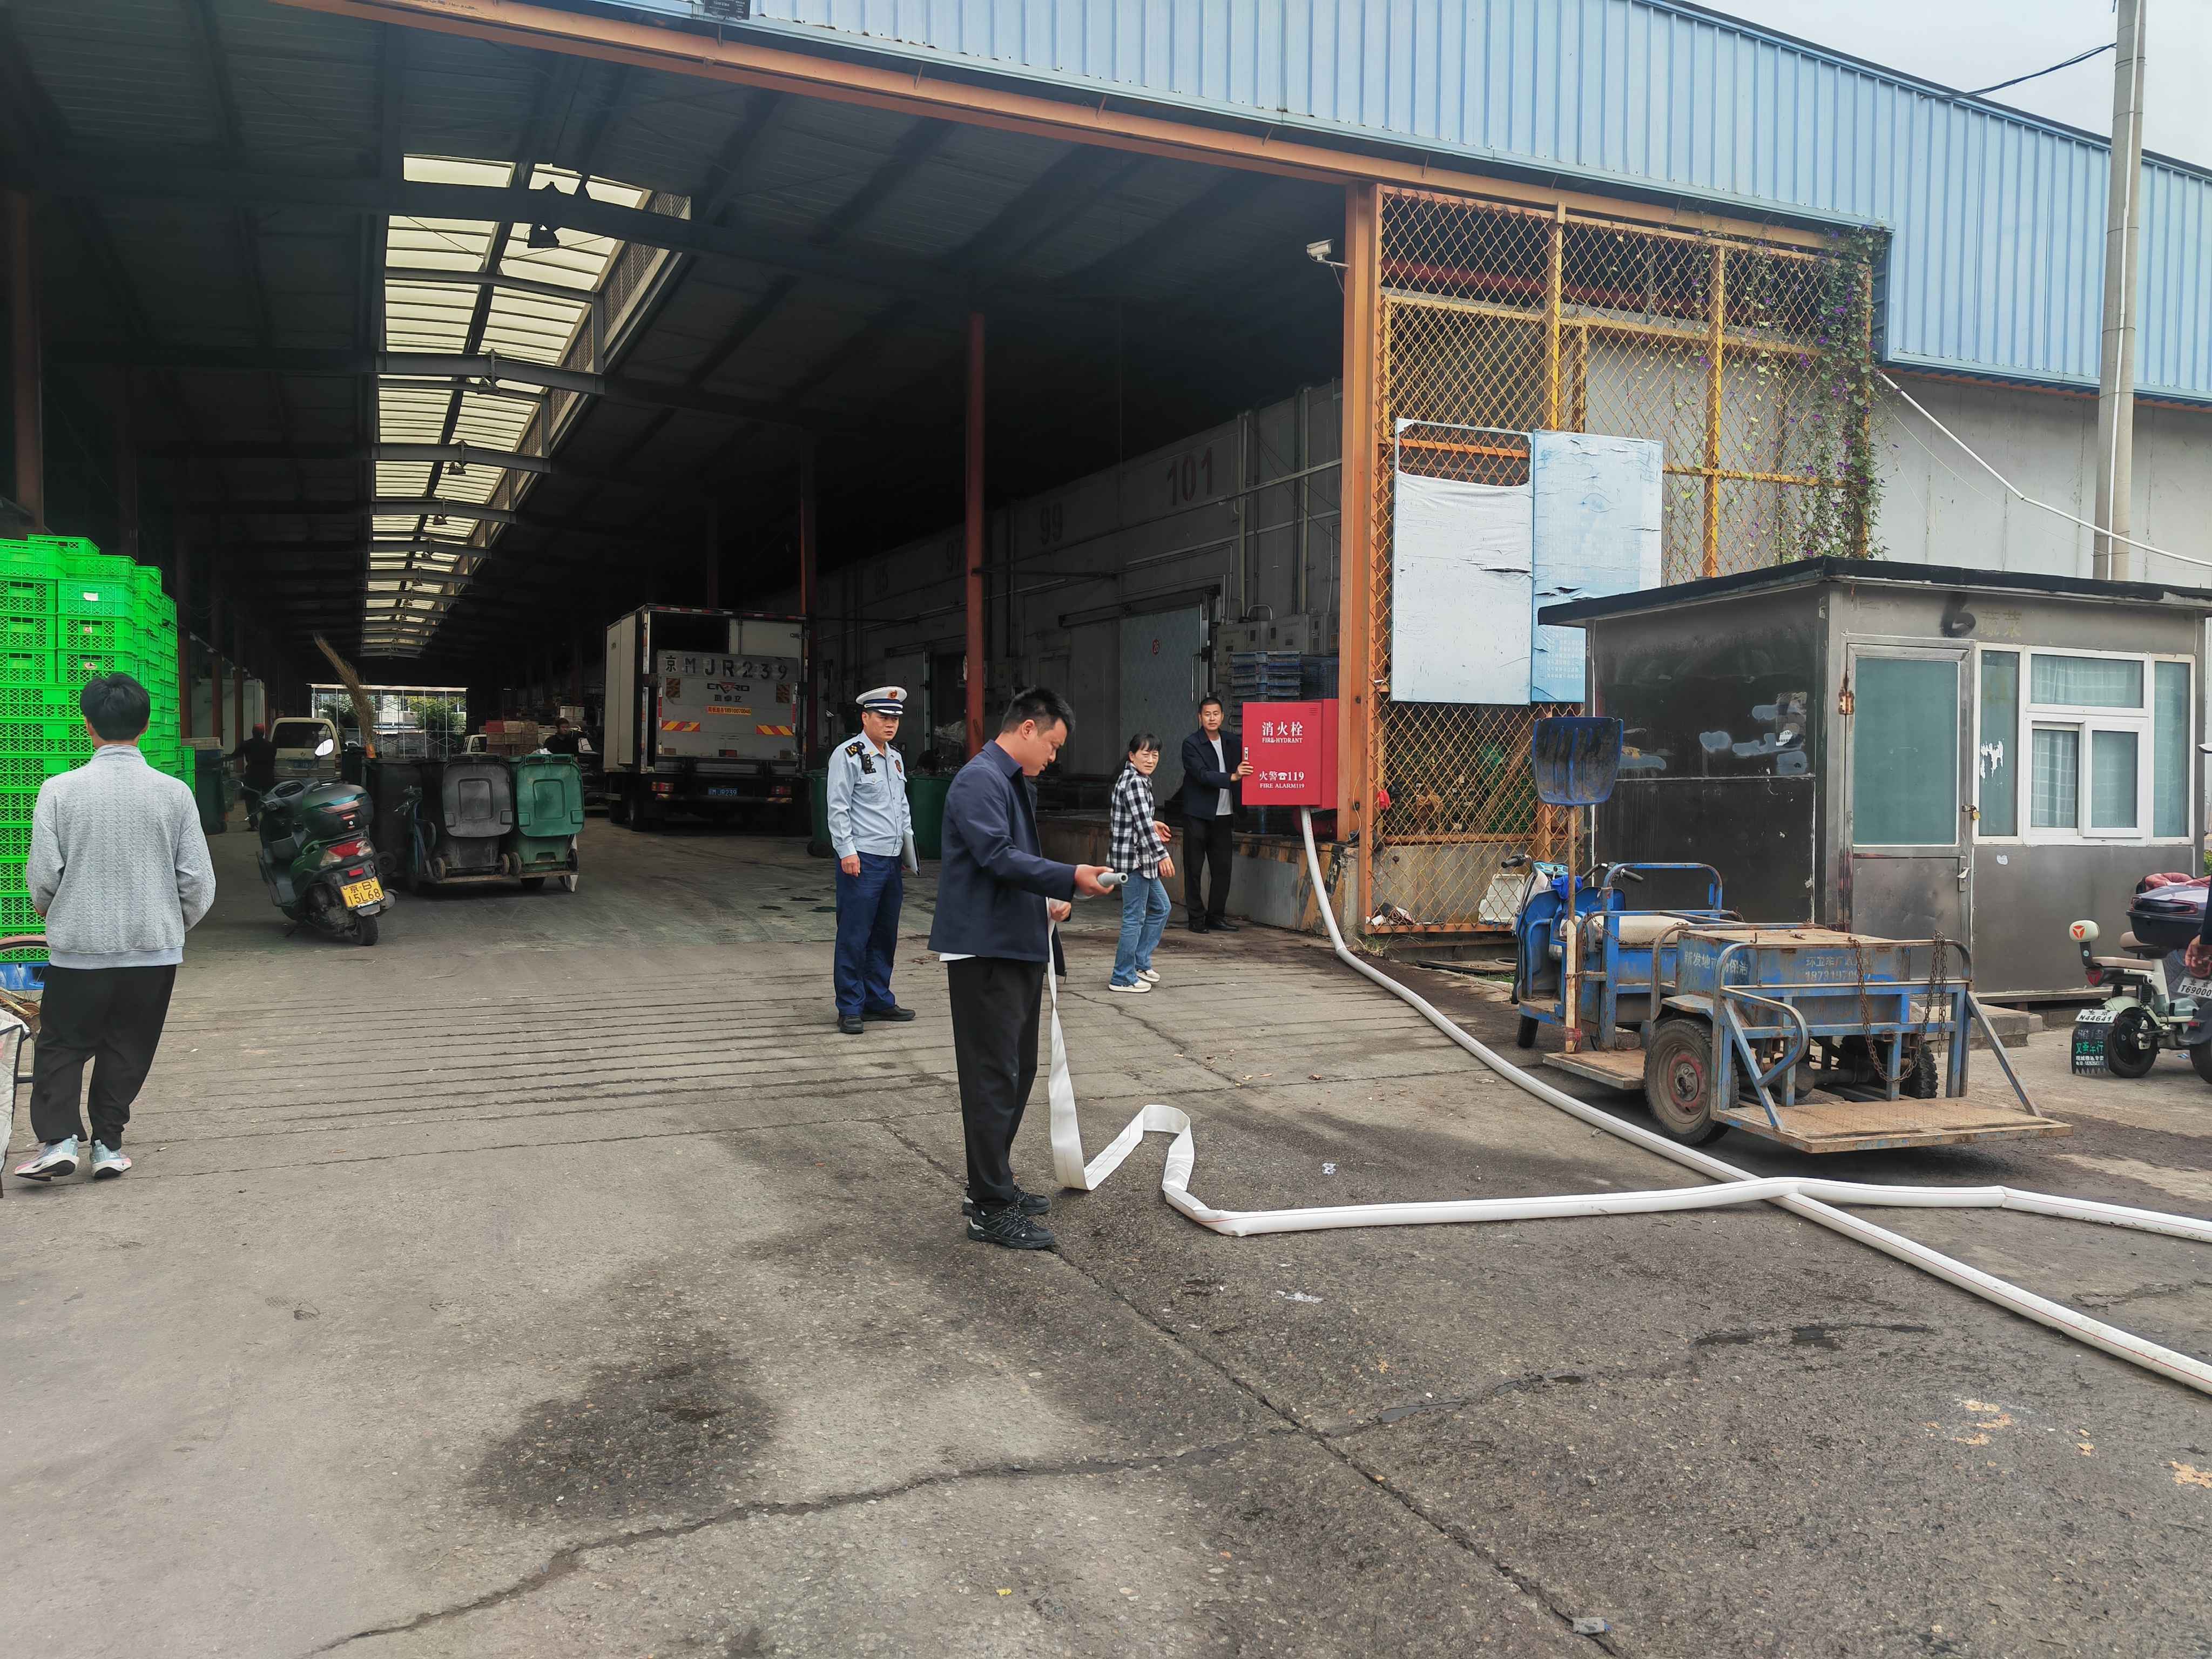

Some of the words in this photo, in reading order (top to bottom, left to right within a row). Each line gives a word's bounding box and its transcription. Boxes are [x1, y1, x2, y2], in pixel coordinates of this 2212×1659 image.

[1166, 447, 1215, 506] 101
[1039, 502, 1064, 545] 99
[947, 536, 963, 572] 97
[665, 656, 788, 680] 京MJR239
[1262, 721, 1303, 736] 消火栓
[1288, 771, 1304, 781] 119
[348, 888, 380, 905] 15L68
[2181, 984, 2212, 996] T69000
